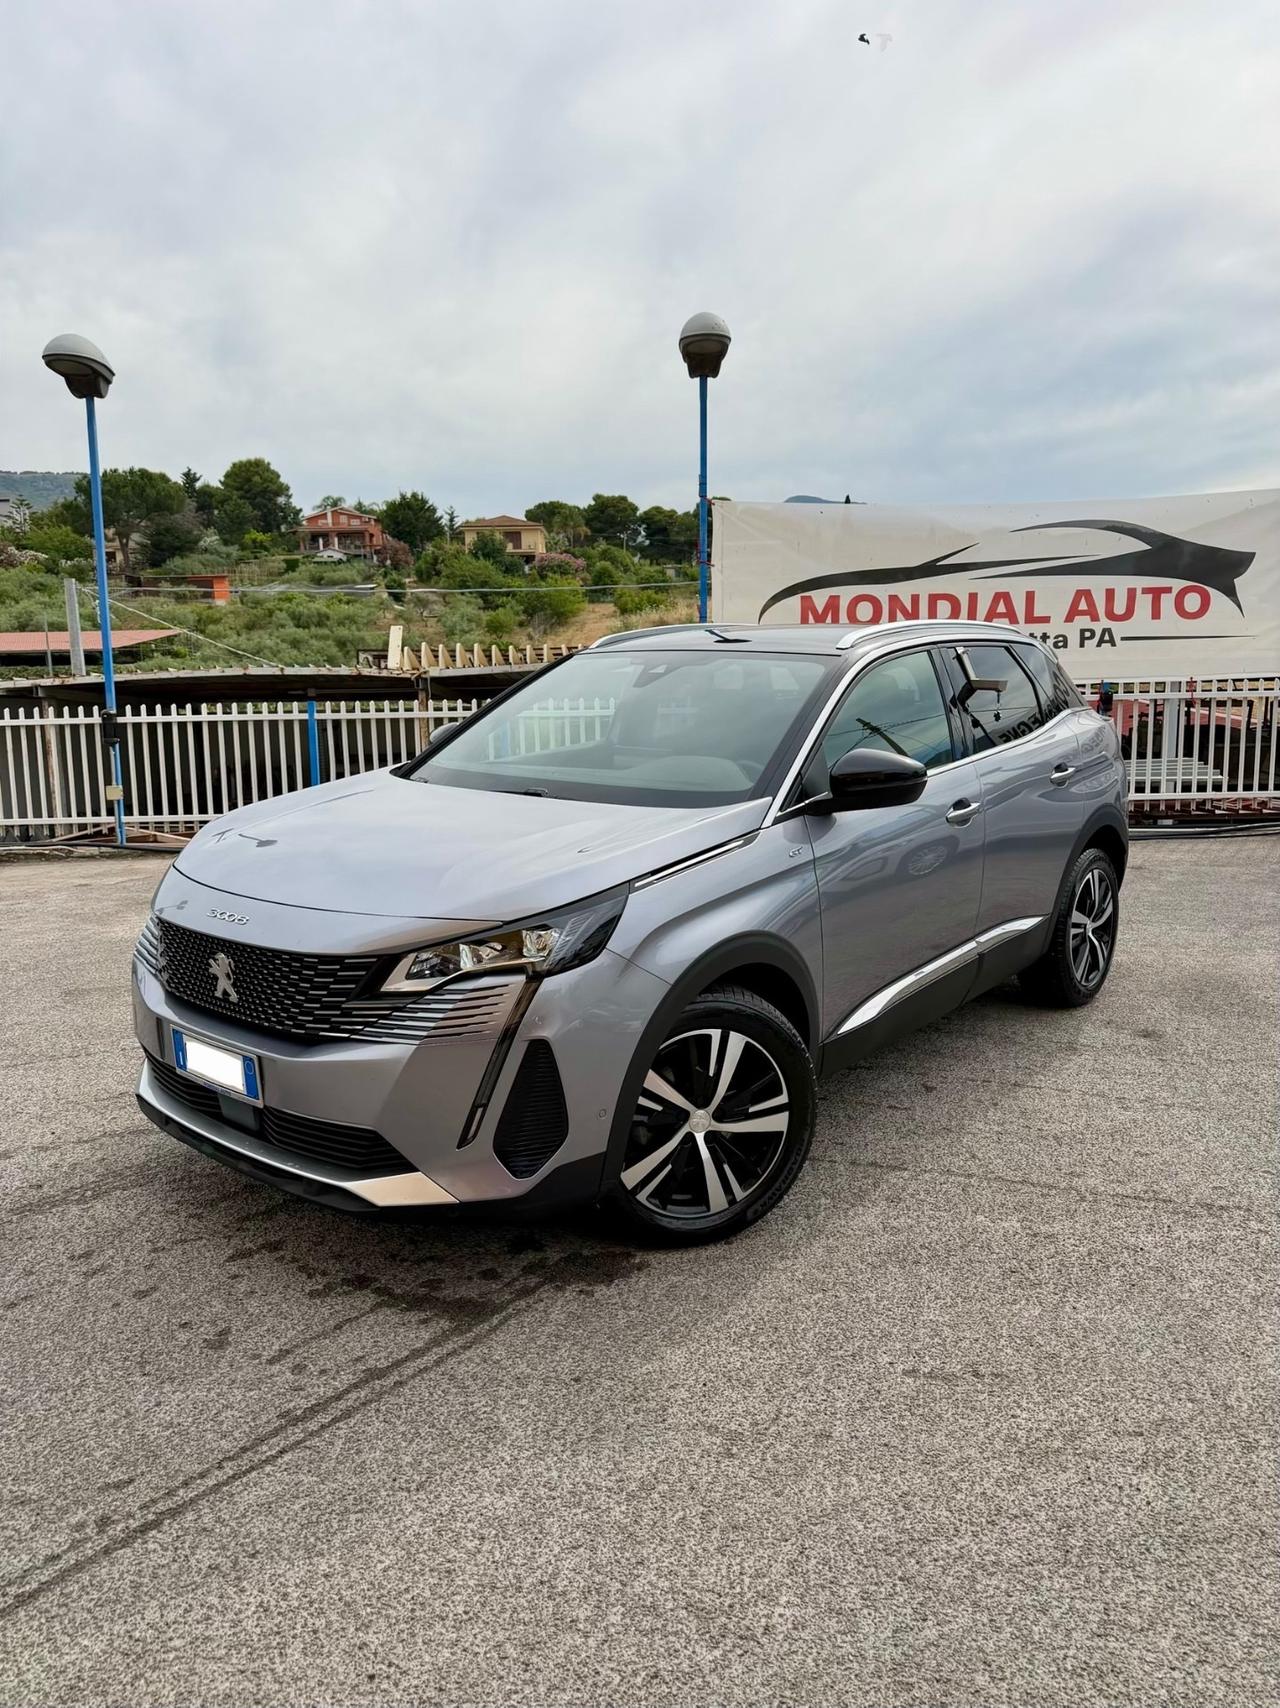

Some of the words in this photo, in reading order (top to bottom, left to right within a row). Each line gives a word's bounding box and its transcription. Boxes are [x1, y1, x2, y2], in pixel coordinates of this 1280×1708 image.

[800, 590, 1051, 625] MONDIAL
[1064, 585, 1211, 623] AUTO
[1079, 627, 1117, 648] PA
